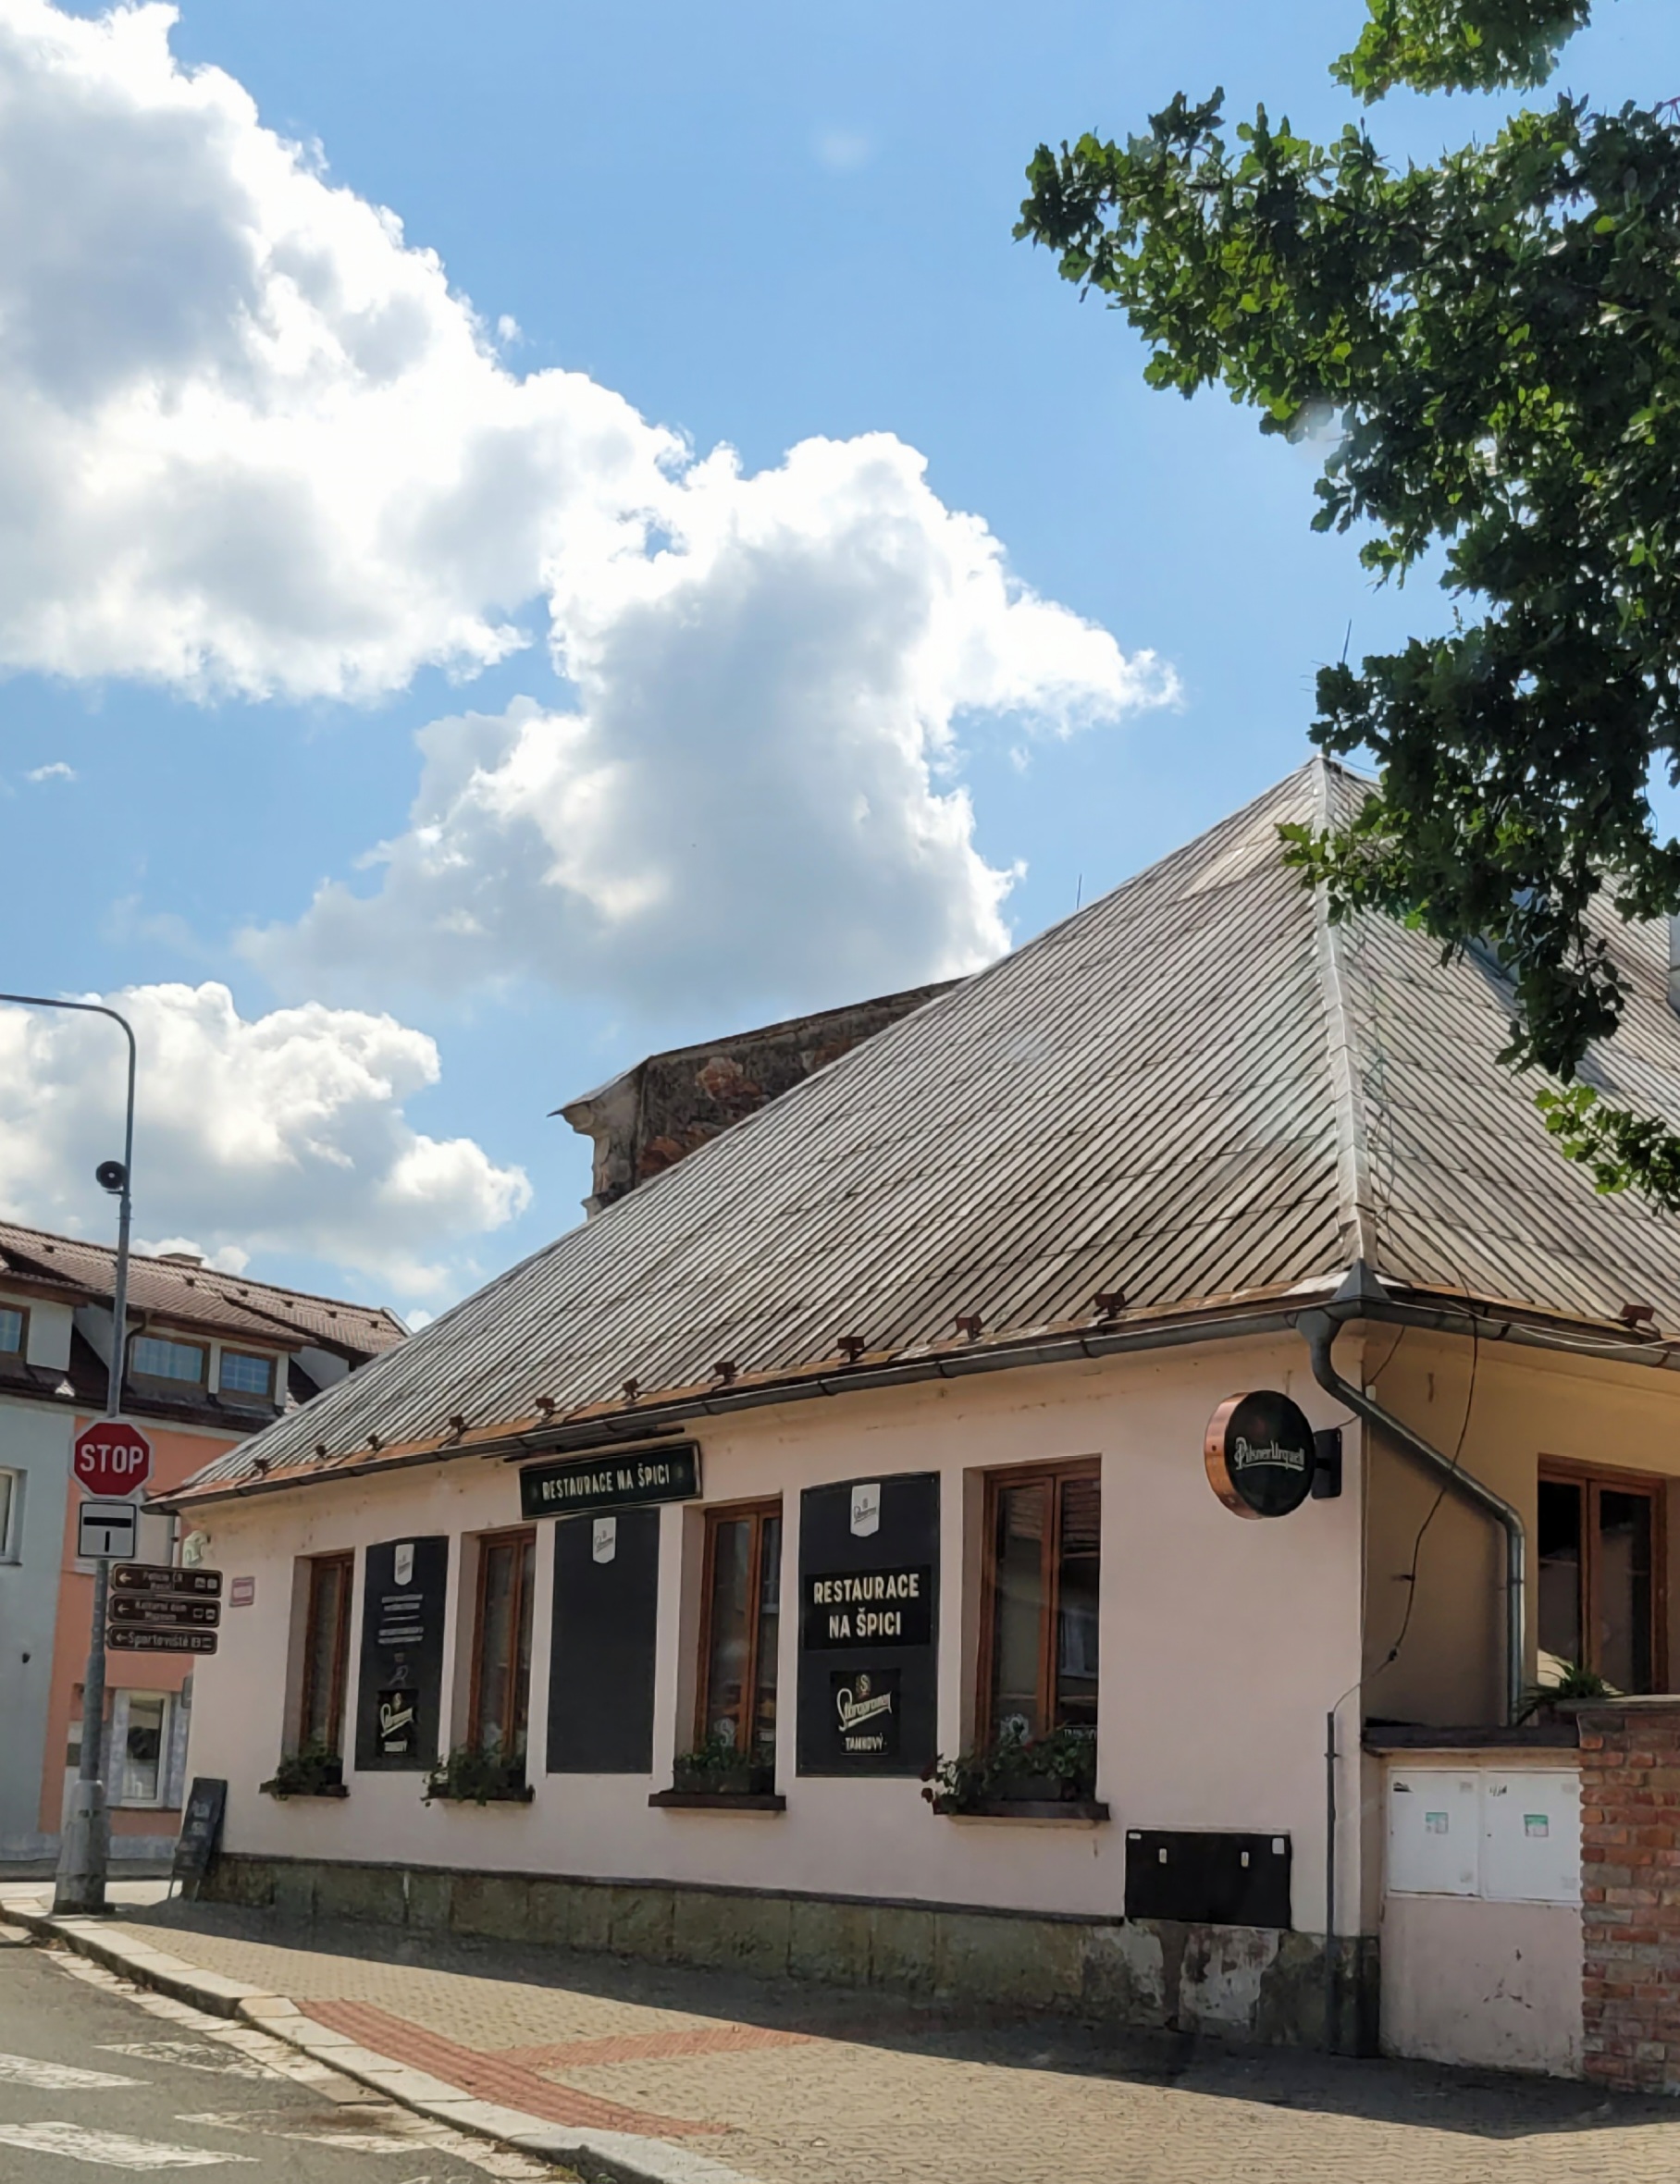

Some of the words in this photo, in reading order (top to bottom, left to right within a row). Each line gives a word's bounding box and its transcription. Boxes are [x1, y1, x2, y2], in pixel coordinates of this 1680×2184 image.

[80, 1443, 144, 1474] STOP
[542, 1471, 614, 1500] RESTAURACE
[616, 1469, 634, 1490] NA
[637, 1463, 671, 1487] ŠPICI
[813, 1573, 920, 1604] RESTAURACE
[829, 1615, 851, 1638] NA
[856, 1607, 901, 1636] ŠPICI
[845, 1732, 883, 1752] TANKOVÝ
